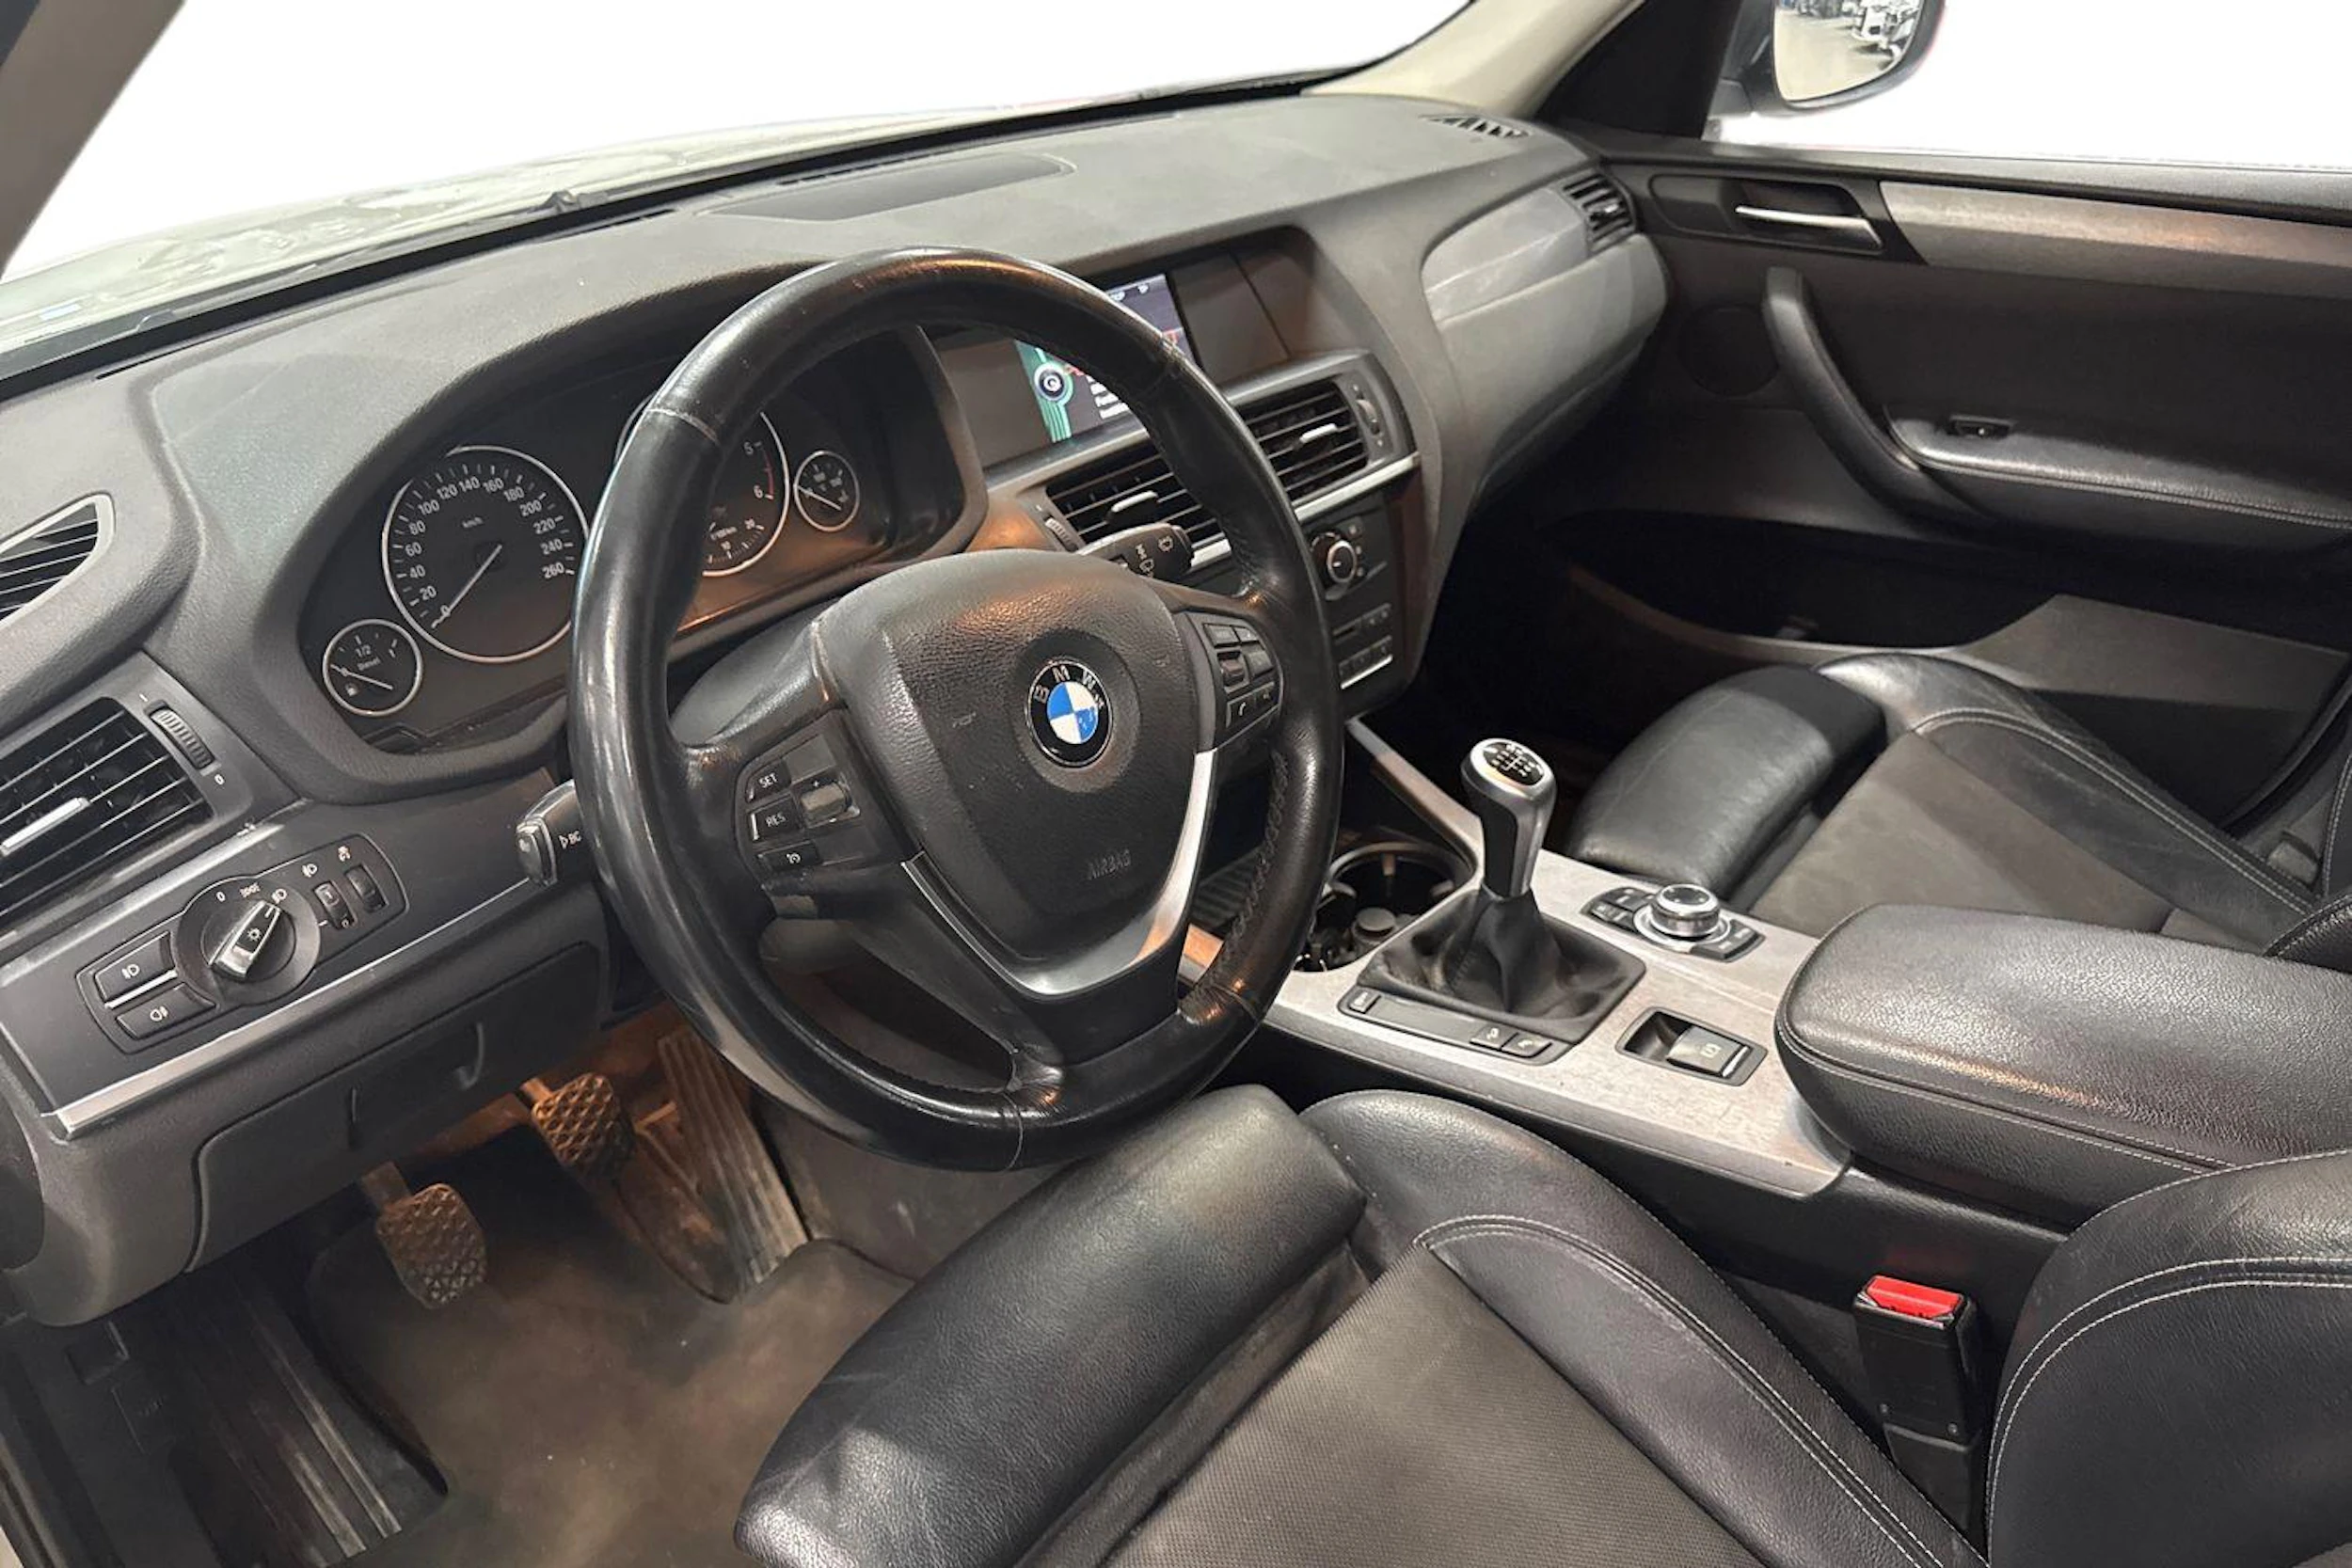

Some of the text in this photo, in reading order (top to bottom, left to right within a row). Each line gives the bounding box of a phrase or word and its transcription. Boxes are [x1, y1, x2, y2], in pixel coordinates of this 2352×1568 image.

[437, 483, 458, 500] 120
[458, 476, 482, 493] 140
[482, 477, 505, 494] 160
[503, 486, 525, 502] 180
[418, 499, 440, 515] 100
[519, 499, 543, 517] 200
[408, 520, 426, 536] 80
[532, 517, 556, 534] 220
[405, 541, 422, 557] 60
[540, 538, 563, 555] 240
[409, 564, 425, 579] 40
[542, 562, 565, 579] 260
[420, 586, 437, 600] 20
[1035, 664, 1096, 705] BMW
[758, 772, 779, 788] SET
[765, 813, 787, 828] RES
[1088, 849, 1132, 880] AIRBAG
